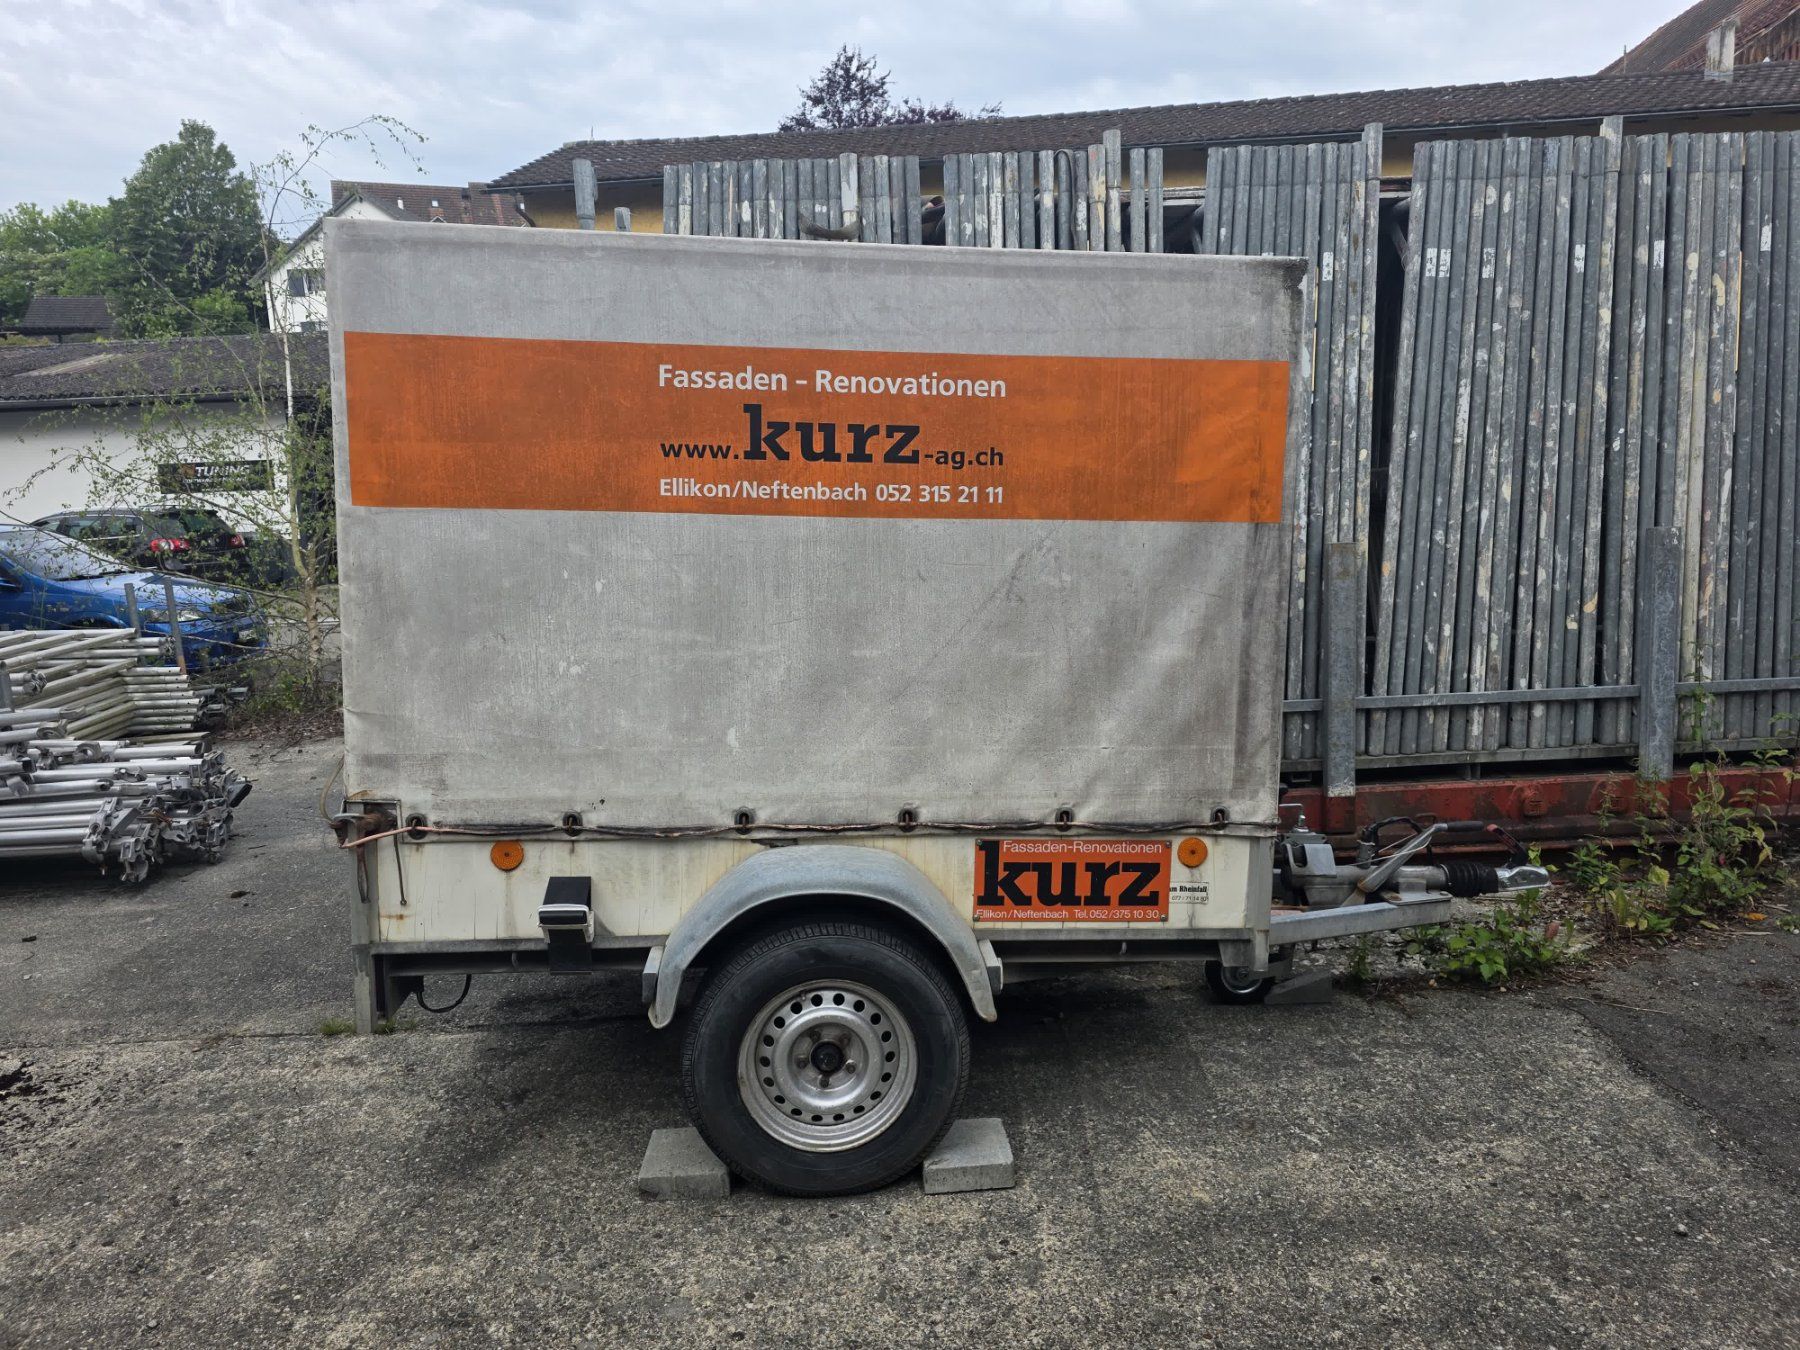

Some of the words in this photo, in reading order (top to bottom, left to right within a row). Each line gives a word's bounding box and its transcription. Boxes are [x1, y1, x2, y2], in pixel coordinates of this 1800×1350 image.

[659, 364, 787, 391] Fassaden
[815, 369, 1006, 398] Renovationen
[659, 478, 867, 502] Ellikon/Neftenbach
[876, 484, 911, 502] 052
[919, 485, 951, 503] 315
[957, 486, 979, 503] 21
[986, 486, 1004, 504] 11
[1003, 840, 1162, 854] Fassaden-Renovationen
[976, 840, 1161, 907] kurz
[976, 909, 1069, 919] Ellikon/Neftenbach
[1132, 909, 1144, 919] 10
[1146, 909, 1159, 919] 30
